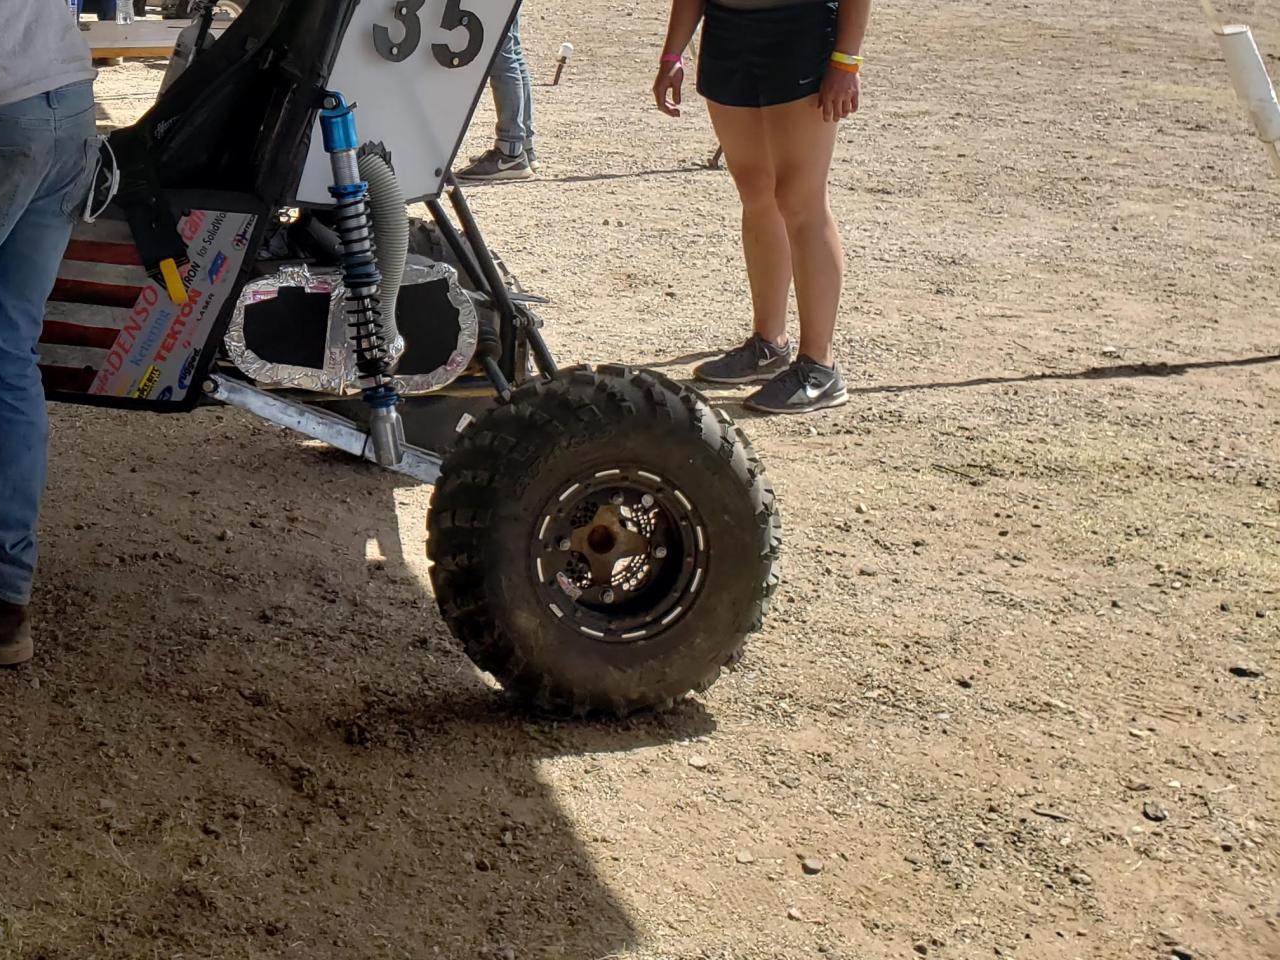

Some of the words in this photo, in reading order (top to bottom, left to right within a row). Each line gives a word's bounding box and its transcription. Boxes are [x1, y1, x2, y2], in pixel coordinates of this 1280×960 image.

[106, 285, 158, 373] DENSO
[129, 309, 171, 366] Kettering
[153, 288, 203, 362] TEKTON
